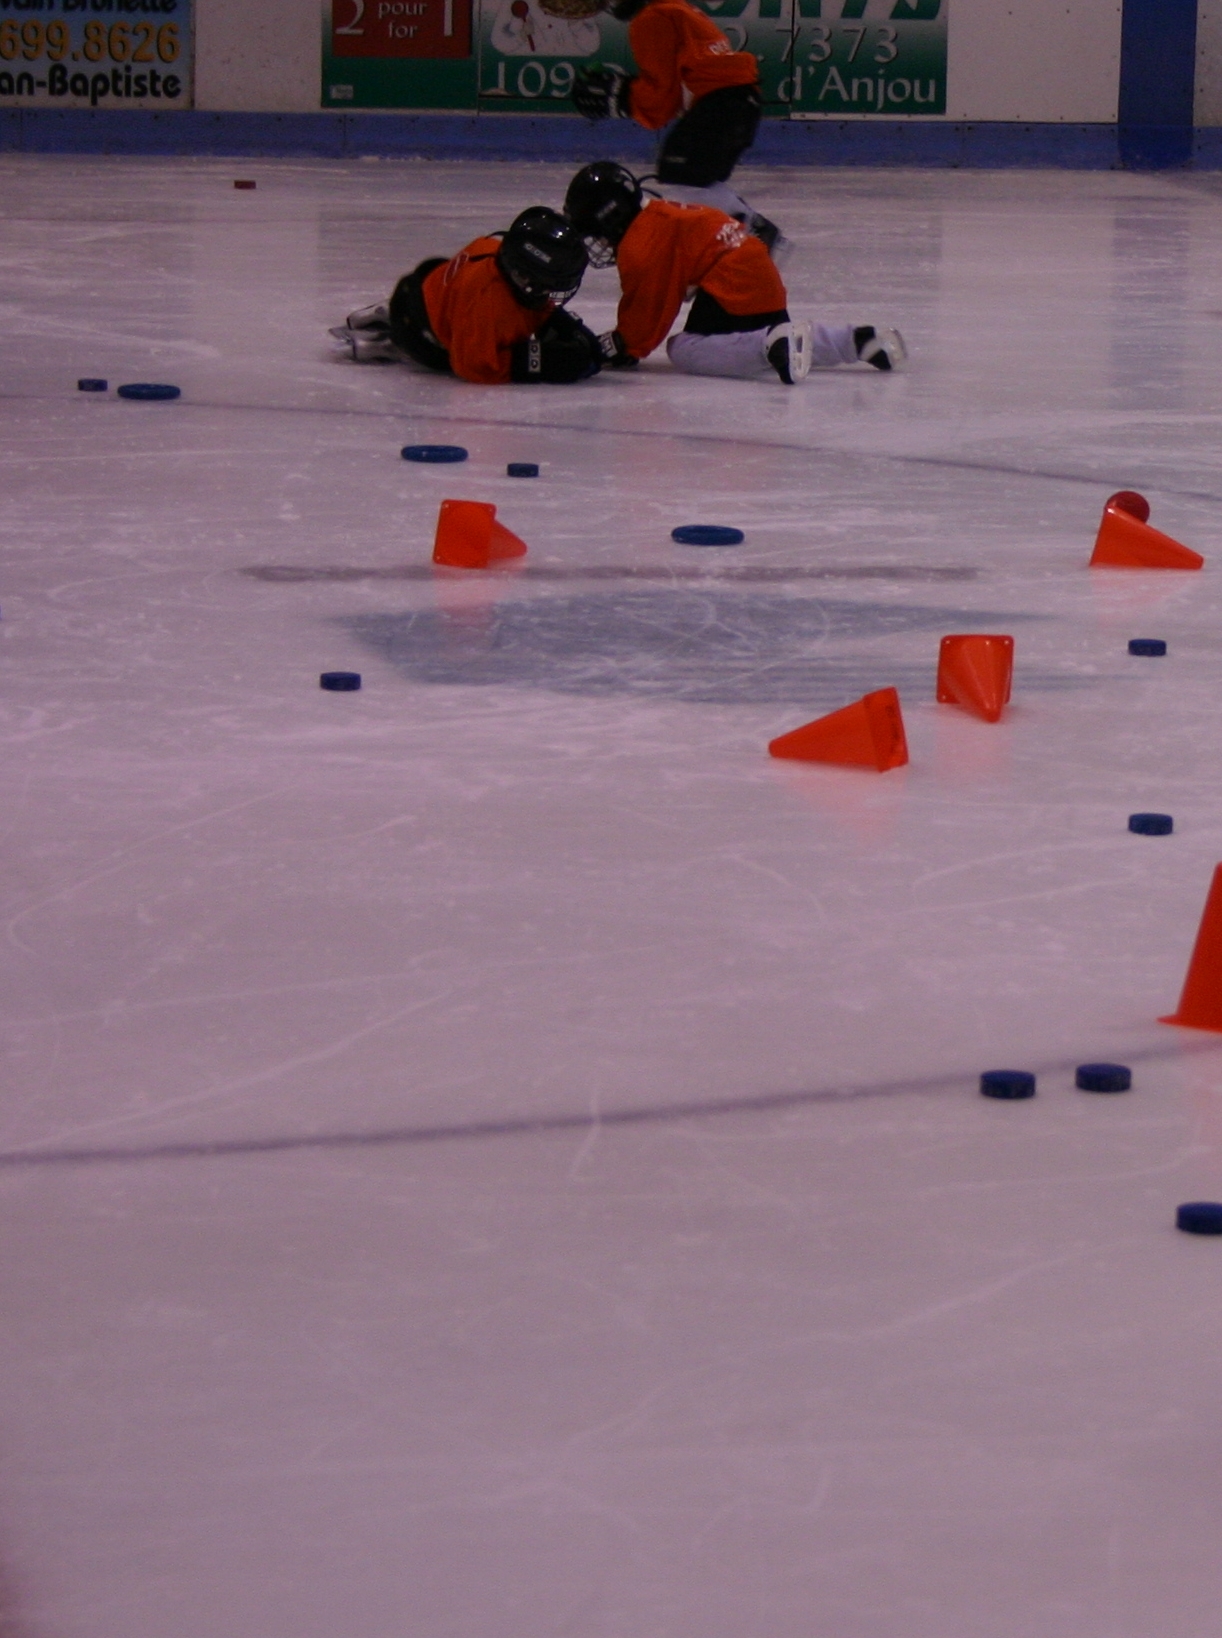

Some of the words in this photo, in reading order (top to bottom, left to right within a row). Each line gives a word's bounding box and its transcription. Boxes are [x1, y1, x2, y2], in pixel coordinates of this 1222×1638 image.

[378, 1, 428, 19] pour
[0, 18, 181, 63] 699.8626
[388, 21, 418, 38] for
[776, 66, 936, 112] d'Anjou
